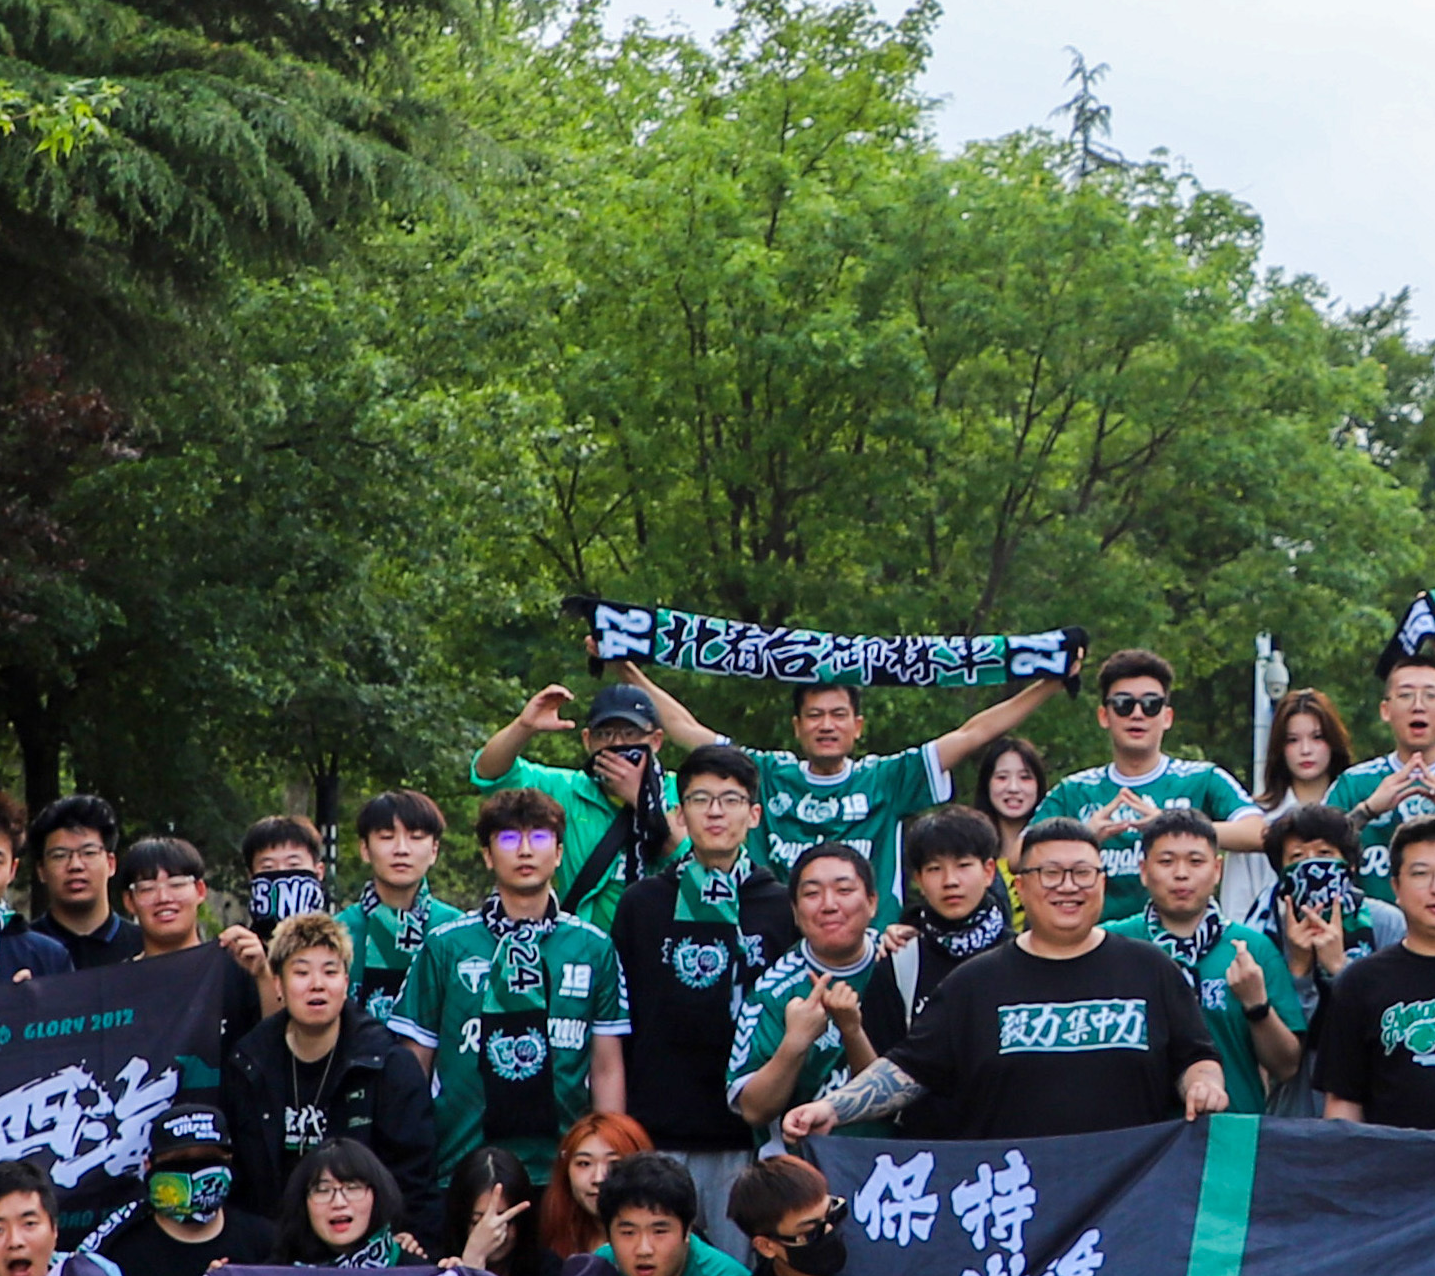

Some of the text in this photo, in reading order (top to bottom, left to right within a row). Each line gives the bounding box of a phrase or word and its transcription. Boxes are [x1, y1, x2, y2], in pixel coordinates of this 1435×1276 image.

[24, 1015, 86, 1041] GLORY
[90, 1007, 135, 1031] 2012
[854, 1149, 1037, 1253] 保持
